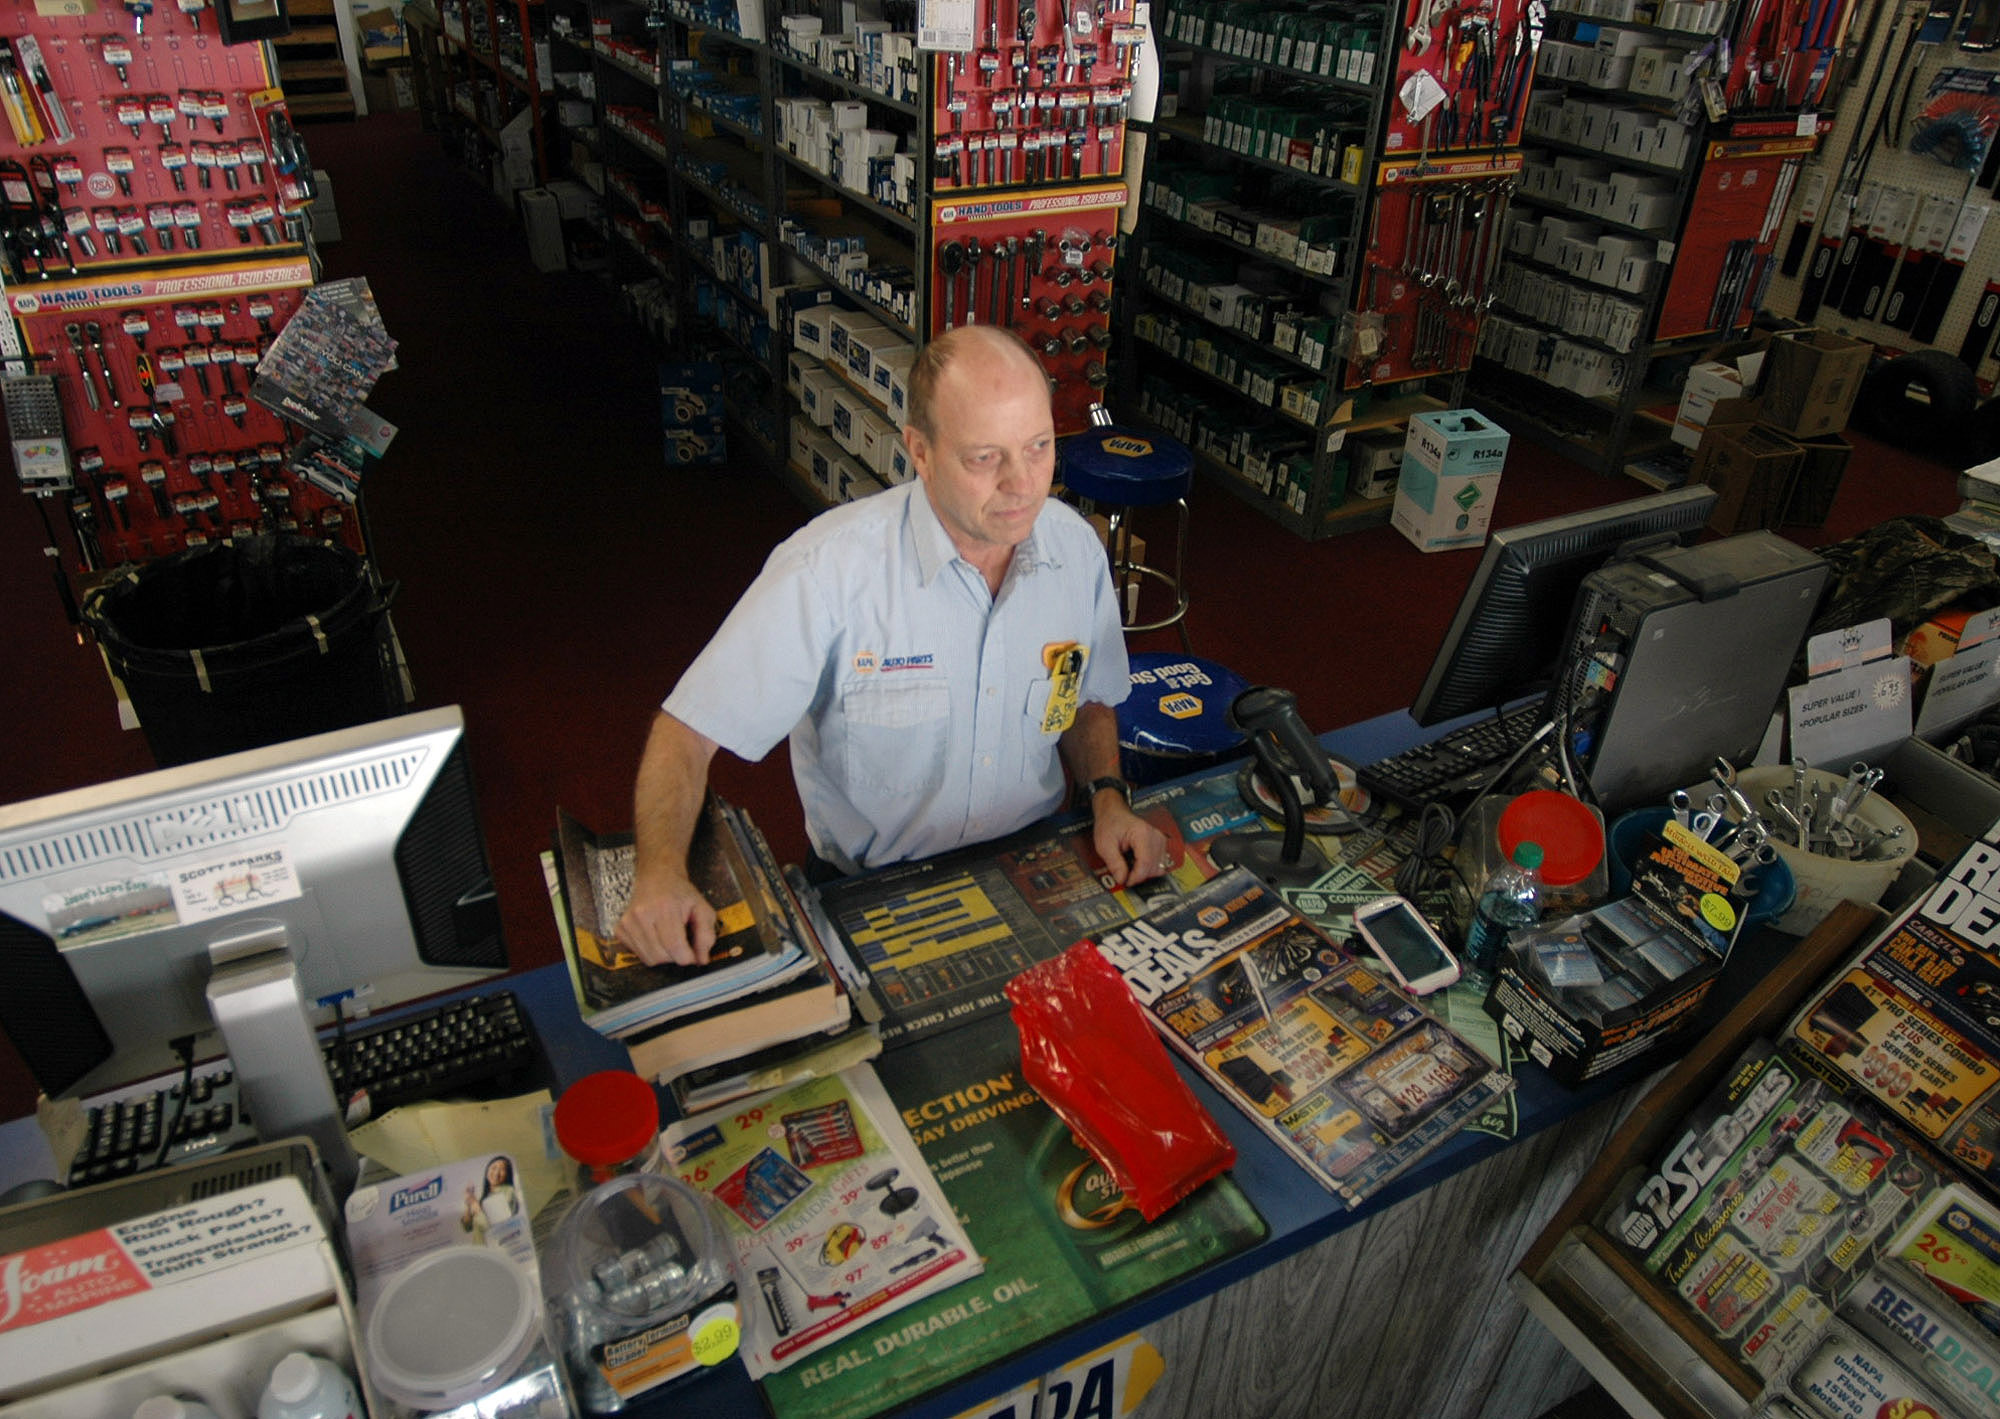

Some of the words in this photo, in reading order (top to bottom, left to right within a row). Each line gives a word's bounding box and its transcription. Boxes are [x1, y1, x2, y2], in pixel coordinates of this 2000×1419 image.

[958, 204, 987, 216] HAND
[991, 201, 1022, 213] TOOLS
[41, 290, 88, 304] HAND
[91, 283, 142, 299] TOOLS
[155, 274, 236, 294] PROFESSIONAL
[266, 266, 302, 282] SERIES
[343, 362, 365, 380] CAN
[1108, 438, 1147, 454] NAPA
[1421, 436, 1442, 460] R134a
[1473, 444, 1503, 460] R134a
[881, 654, 905, 668] AUTO
[906, 653, 934, 667] PARTS
[1155, 662, 1202, 678] Good
[1128, 670, 1157, 686] Stu
[1181, 672, 1213, 689] Get
[1166, 697, 1198, 714] NAPA
[1802, 697, 1828, 713] SUPER
[178, 861, 227, 884] SCOTT
[231, 850, 284, 871] SPARKS
[1097, 919, 1180, 972] REAL
[1909, 918, 1961, 957] CARLYLE
[1121, 928, 1221, 1008] DEALS
[1880, 997, 1905, 1018] PRO
[1903, 1013, 1943, 1046] SERIES
[1941, 1041, 1986, 1077] COMBO
[1893, 1021, 1923, 1046] PLUS
[1790, 1045, 1850, 1093] MASTER
[1879, 1038, 1922, 1073] SERVICE
[1919, 1066, 1948, 1091] CART
[1902, 1040, 1924, 1059] PRO
[1922, 1054, 1959, 1084] SERIES
[905, 1074, 1014, 1128] ECTION
[950, 1093, 1043, 1134] DRIVING.
[735, 1110, 764, 1132] 29
[941, 1147, 973, 1172] better
[394, 1181, 438, 1210] Purell
[117, 1208, 198, 1237] Engine
[123, 1225, 171, 1246] Run
[178, 1198, 267, 1231] Rough?
[778, 1194, 832, 1236] HOLIDAY
[1625, 1214, 1656, 1246] NAPA
[133, 1232, 202, 1258] Stuck
[208, 1207, 286, 1238] Parts?
[142, 1220, 294, 1270] Transmission
[1660, 1244, 1700, 1286] Truck
[1688, 1184, 1747, 1250] Accessories
[1915, 1232, 1953, 1265] 26
[150, 1256, 206, 1279] Shift
[212, 1223, 313, 1260] Strange?
[643, 1316, 690, 1344] Terminal
[1866, 1283, 1948, 1349] REAL
[693, 1324, 734, 1355] $2.99
[800, 1345, 872, 1389] REAL.
[873, 1298, 993, 1358] DURABLE.
[992, 1276, 1039, 1304] OIL.
[1828, 1354, 1892, 1402] Universal
[1849, 1352, 1888, 1384] NAPA
[1808, 1384, 1848, 1418] Motor
[1821, 1378, 1867, 1414] 15W40
[1834, 1372, 1870, 1401] Fleet
